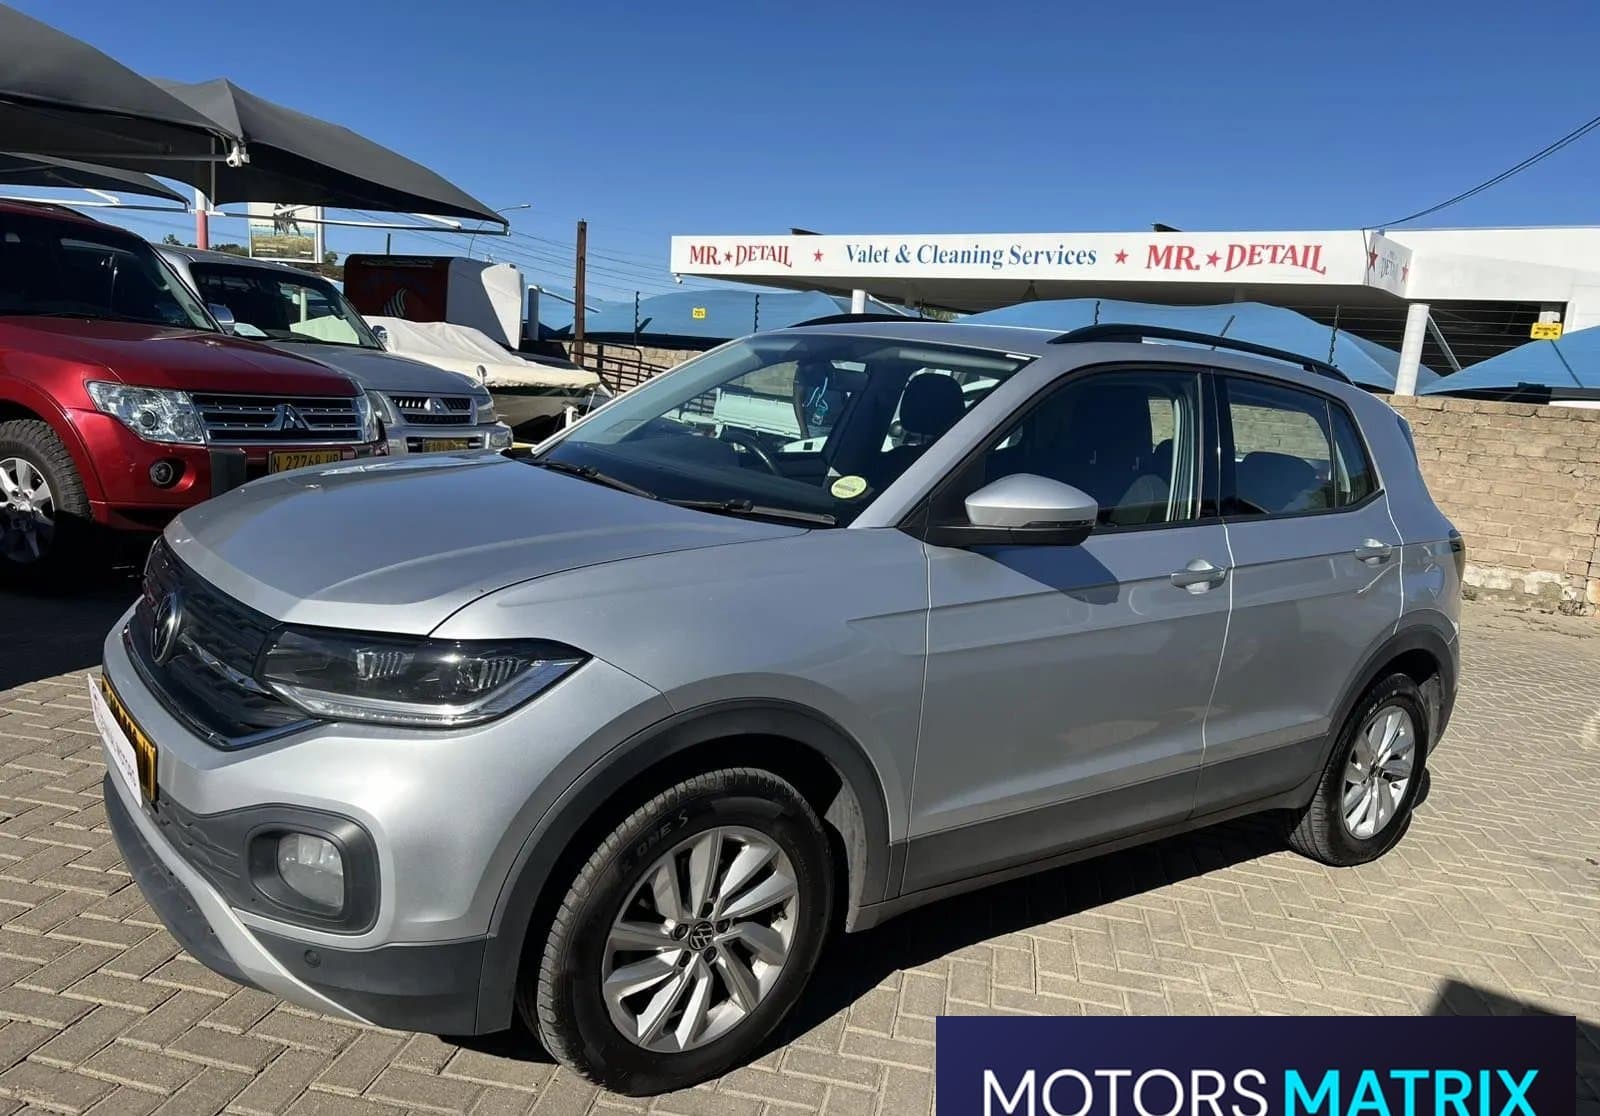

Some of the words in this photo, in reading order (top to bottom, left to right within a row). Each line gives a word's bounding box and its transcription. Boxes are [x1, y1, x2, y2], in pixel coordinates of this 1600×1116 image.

[690, 245, 721, 265] MR.
[736, 245, 792, 268] DETAIL
[847, 244, 890, 263] Valet
[895, 244, 911, 263] &
[917, 244, 1004, 270] Cleaning
[1008, 244, 1097, 265] Services
[1145, 244, 1200, 270] MR.
[1224, 244, 1326, 275] DETAIL
[637, 822, 672, 856] ONE
[678, 808, 689, 829] S
